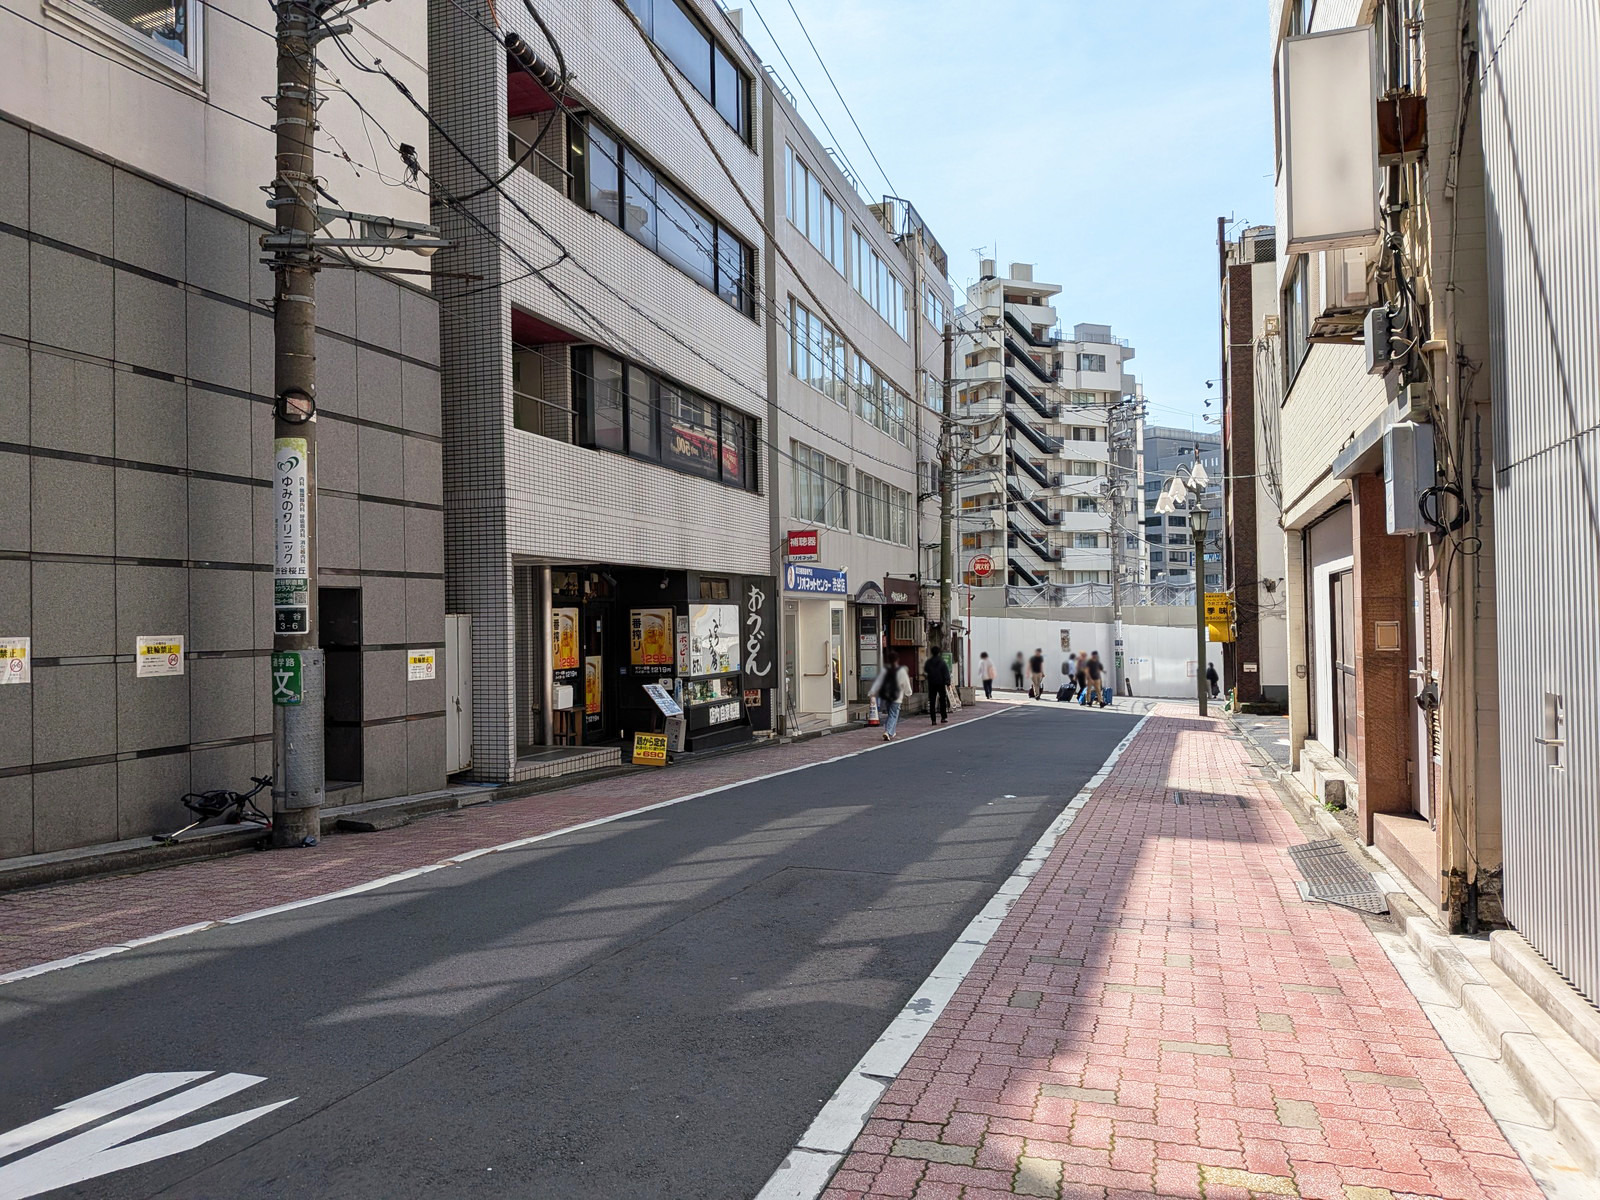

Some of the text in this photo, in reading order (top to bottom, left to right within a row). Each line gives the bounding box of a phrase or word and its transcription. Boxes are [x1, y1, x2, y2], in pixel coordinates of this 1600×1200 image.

[282, 476, 293, 564] ゆみのクリニック
[797, 576, 831, 591] リオネットセンター
[632, 613, 641, 651] 一番搾り
[745, 584, 771, 676] おうどん
[680, 636, 688, 663] ホッピー
[273, 669, 294, 695] 文
